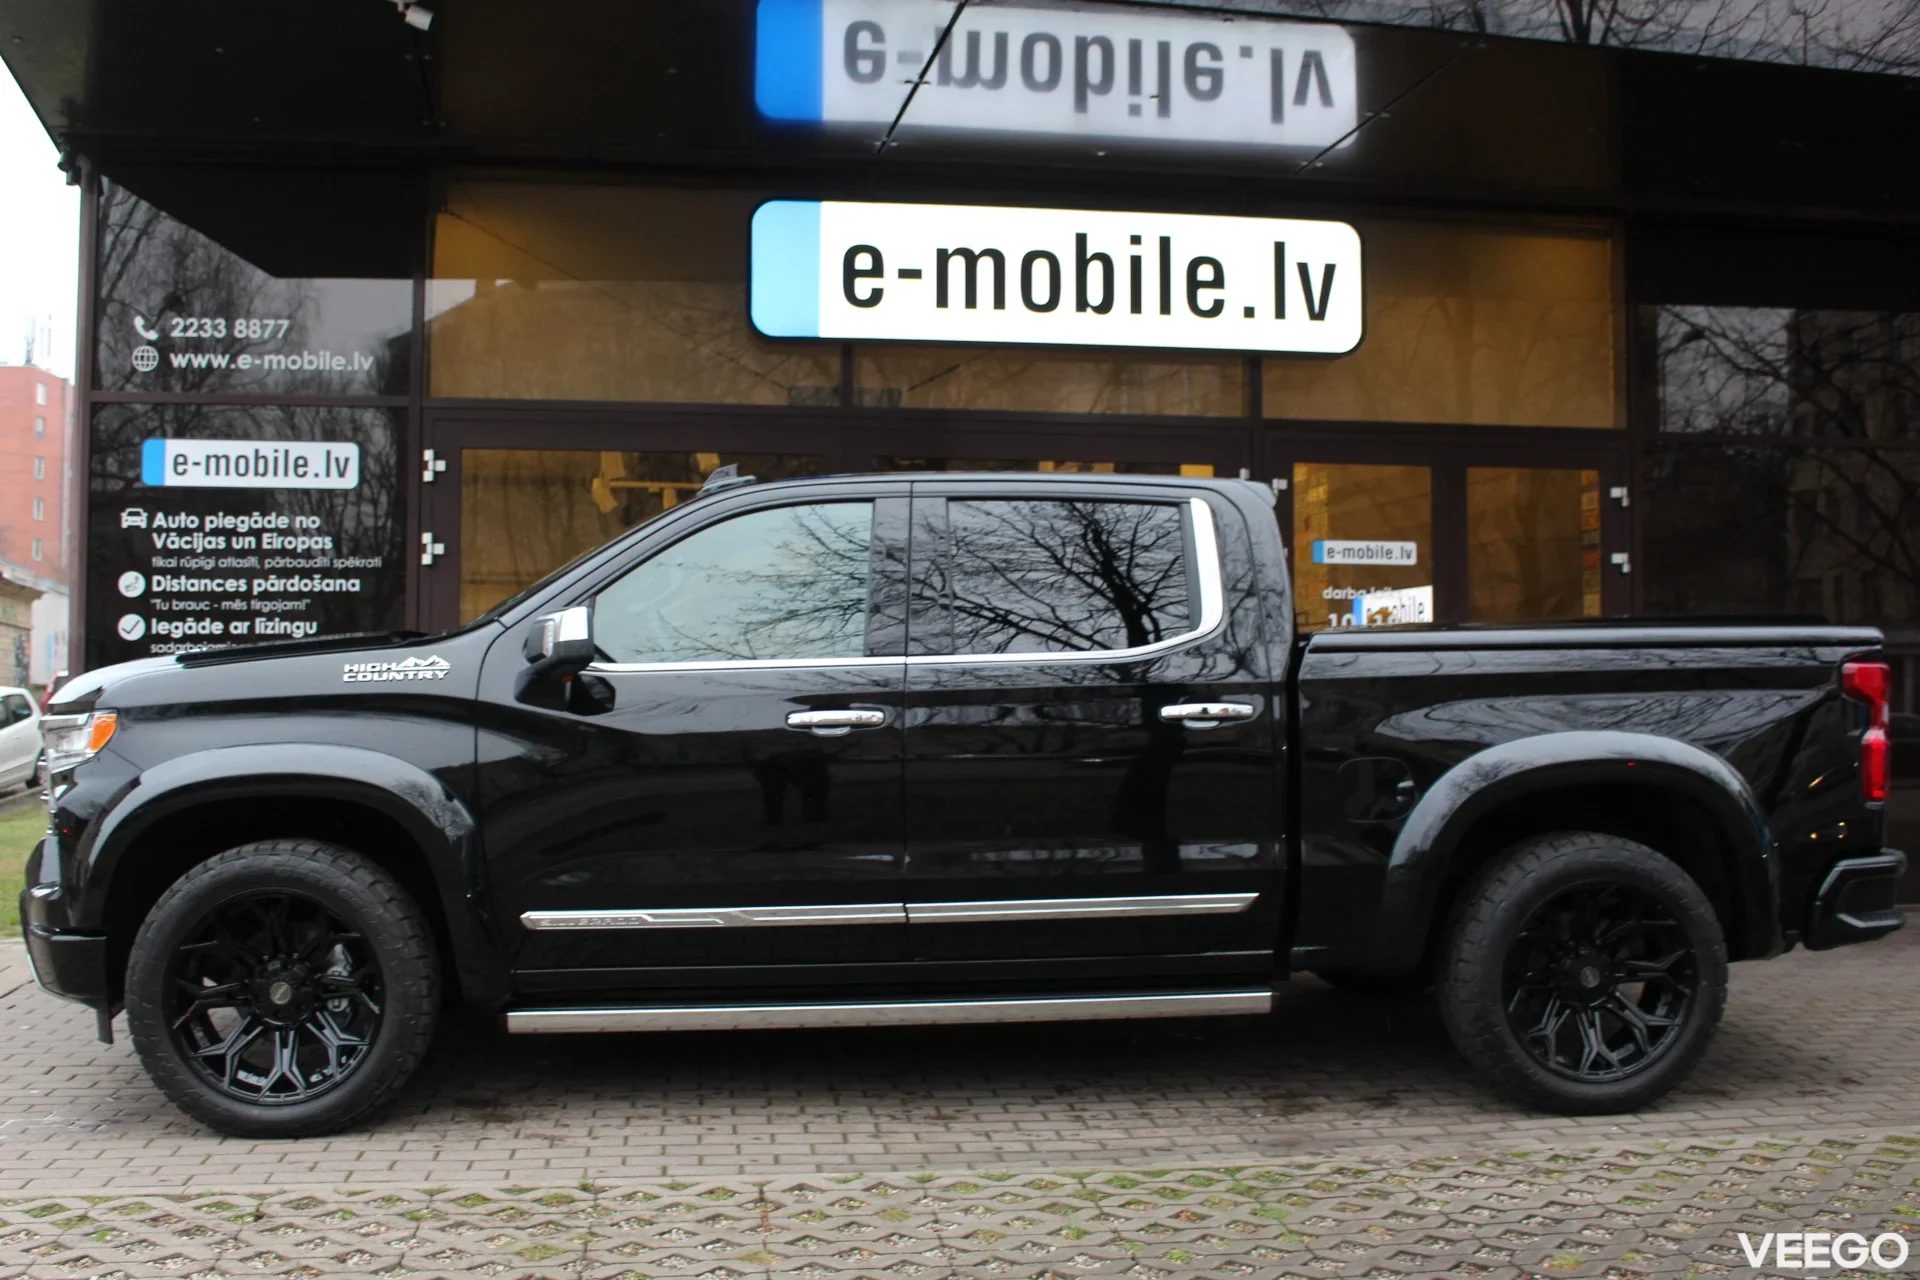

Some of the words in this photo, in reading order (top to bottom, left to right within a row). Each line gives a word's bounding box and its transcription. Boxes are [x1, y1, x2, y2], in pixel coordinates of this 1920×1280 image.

[843, 233, 1337, 321] e-mobile.lv
[170, 318, 227, 339] 2233
[233, 318, 290, 339] 8877
[170, 351, 374, 372] www.e-mobile.lv
[173, 448, 351, 479] e-mobile.lv
[152, 512, 199, 529] Auto
[204, 512, 291, 532] piegāde
[295, 515, 321, 529] no
[152, 533, 226, 552] Vācijas
[231, 536, 256, 550] un
[261, 533, 333, 552] Eiropas
[1327, 545, 1413, 560] e-mobile.lv
[151, 556, 178, 569] tikai
[151, 576, 247, 592] Distances
[252, 574, 361, 594] pārdošana
[171, 599, 211, 611] brauc
[221, 599, 248, 611] mēs
[151, 617, 224, 638] Iegāde
[229, 620, 251, 634] ar
[254, 617, 318, 638] līzingu
[343, 671, 450, 682] COUNTRY
[344, 662, 397, 672] HIGH
